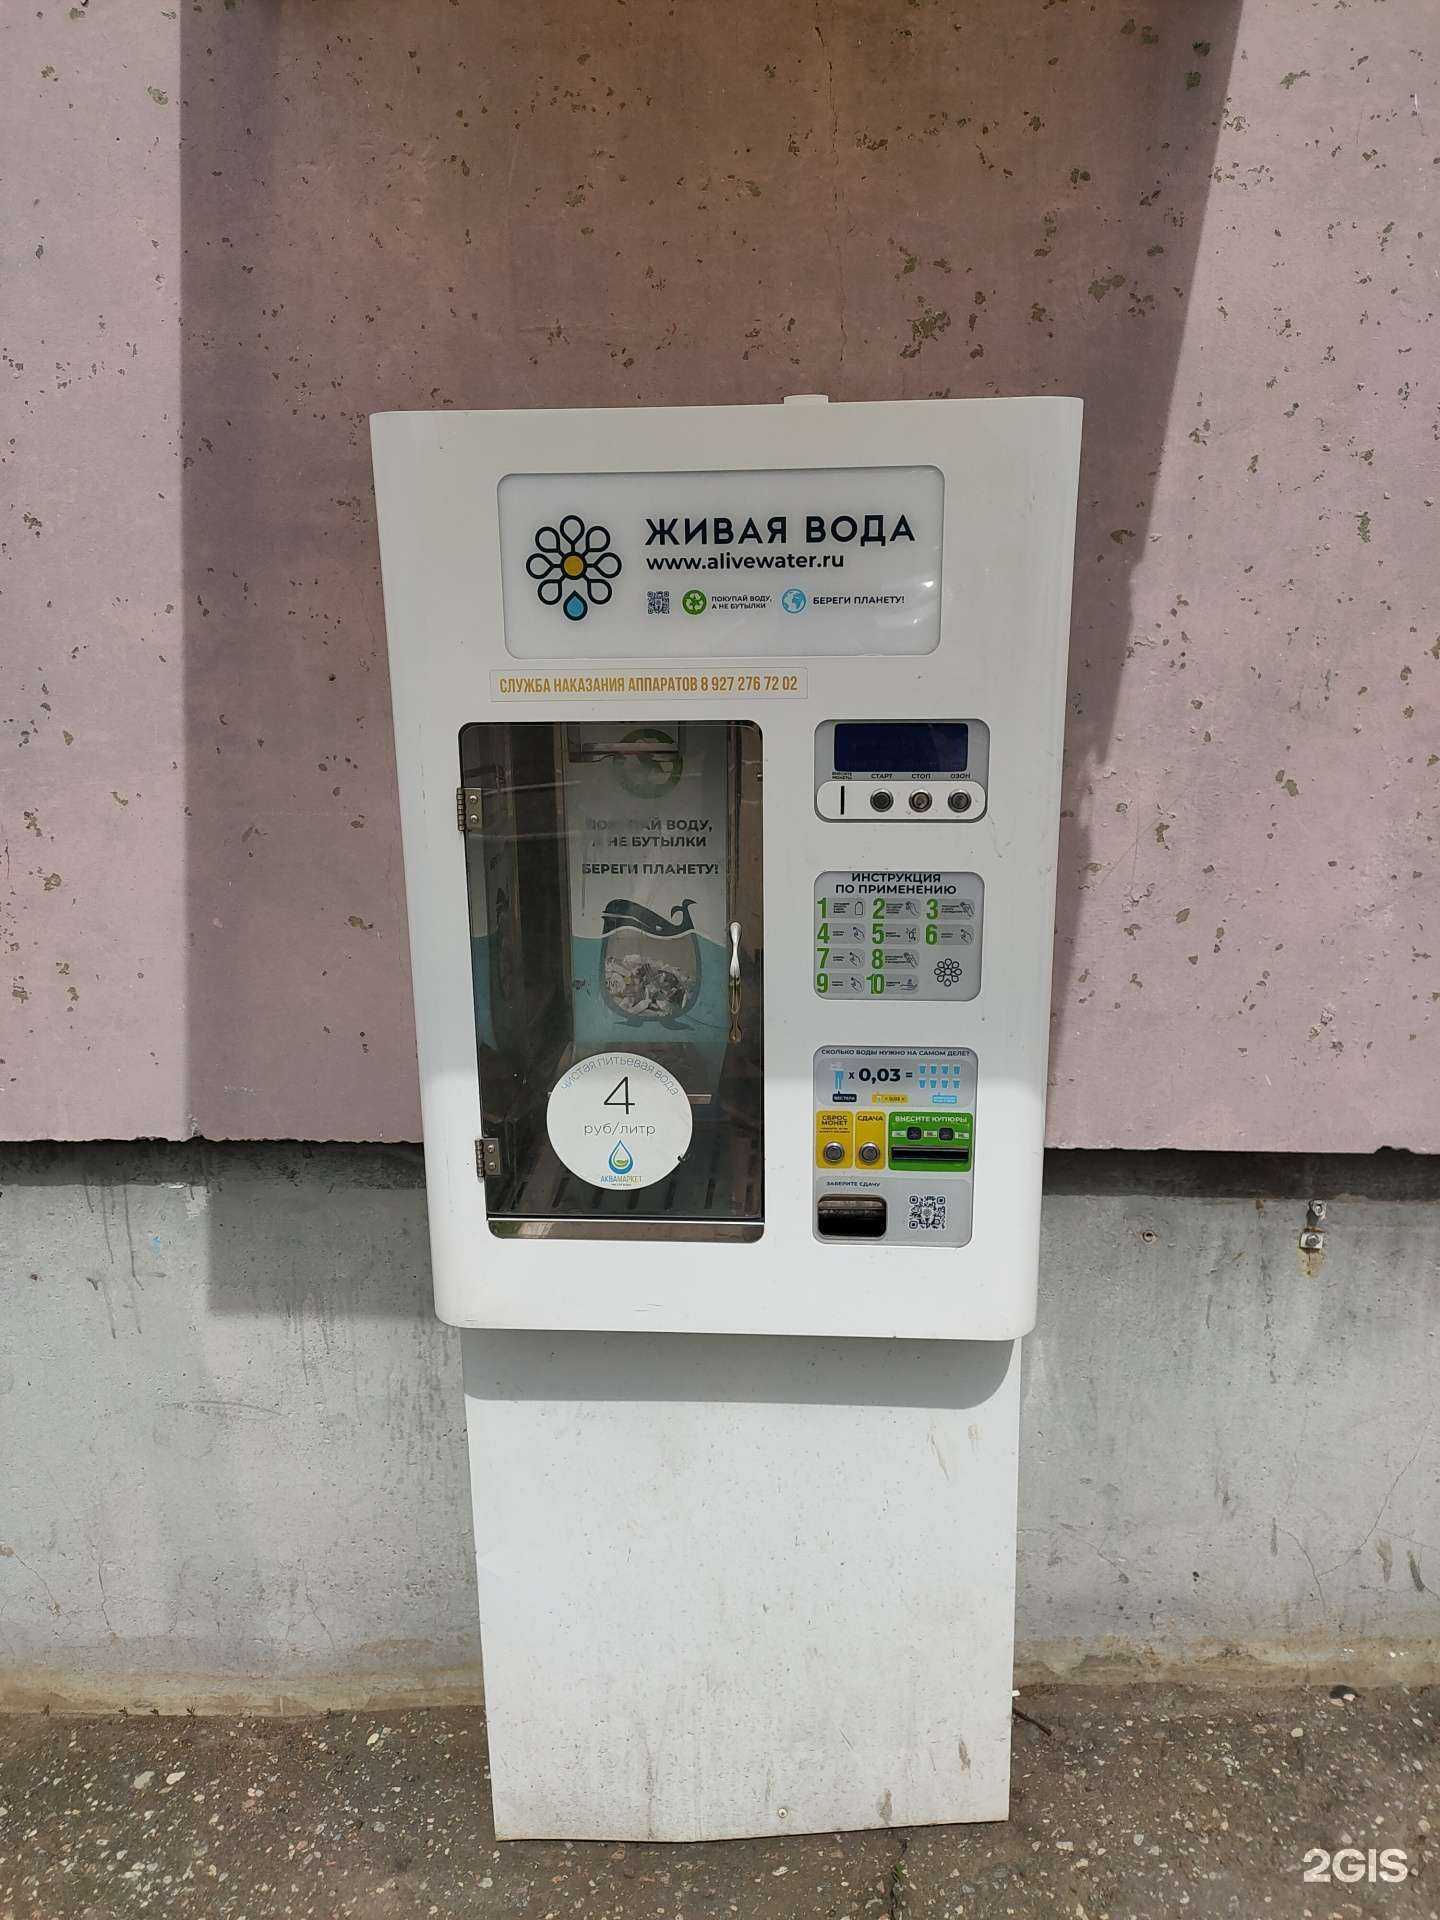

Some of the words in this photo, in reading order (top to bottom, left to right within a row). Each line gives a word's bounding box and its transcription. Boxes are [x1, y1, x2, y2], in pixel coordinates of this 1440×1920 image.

[645, 516, 787, 546] ЖИВАЯ
[805, 514, 916, 547] ВОДА
[646, 552, 845, 571] www.alivewater.ru
[711, 594, 749, 602] ПОКУПАЙ
[750, 594, 773, 603] ВОДУ,
[730, 602, 766, 610] БУТЫЛКИ
[813, 596, 851, 605] БЕРЕГИ
[854, 595, 905, 605] ПЛАНЕТУ!
[499, 677, 551, 694] СЛУЖБА
[553, 676, 625, 693] НАКАЗАНИЯ
[628, 676, 698, 692] АППАРАТОВ
[701, 676, 709, 691] 8
[711, 675, 735, 691] 927
[737, 675, 761, 691] 276
[764, 675, 779, 691] 72
[782, 675, 798, 691] 02
[667, 819, 713, 833] ВОДУ,
[632, 836, 707, 847] БУТЫЛКИ
[582, 863, 639, 875] БЕРЕГИ
[642, 863, 720, 875] ПЛАНЕТУ!
[851, 872, 941, 884] ИНСТРУКЦИЯ
[835, 884, 855, 894] ПО
[858, 884, 957, 895] ПРИМЕНЕНИЮ
[817, 897, 827, 918] 1
[872, 898, 886, 919] 2
[926, 898, 939, 920] 3
[817, 923, 830, 944] 4
[872, 923, 885, 945] 5
[925, 924, 938, 945] 6
[816, 948, 830, 969] 7
[871, 948, 884, 970] 8
[816, 973, 828, 994] 9
[866, 973, 885, 995] 10
[597, 1056, 655, 1073] питьевая
[654, 1071, 679, 1096] вода
[858, 1068, 901, 1084] 0,03
[604, 1076, 636, 1115] 4
[584, 1122, 656, 1137] руб/литр
[600, 1175, 642, 1183] АКВАМАРКЕТ
